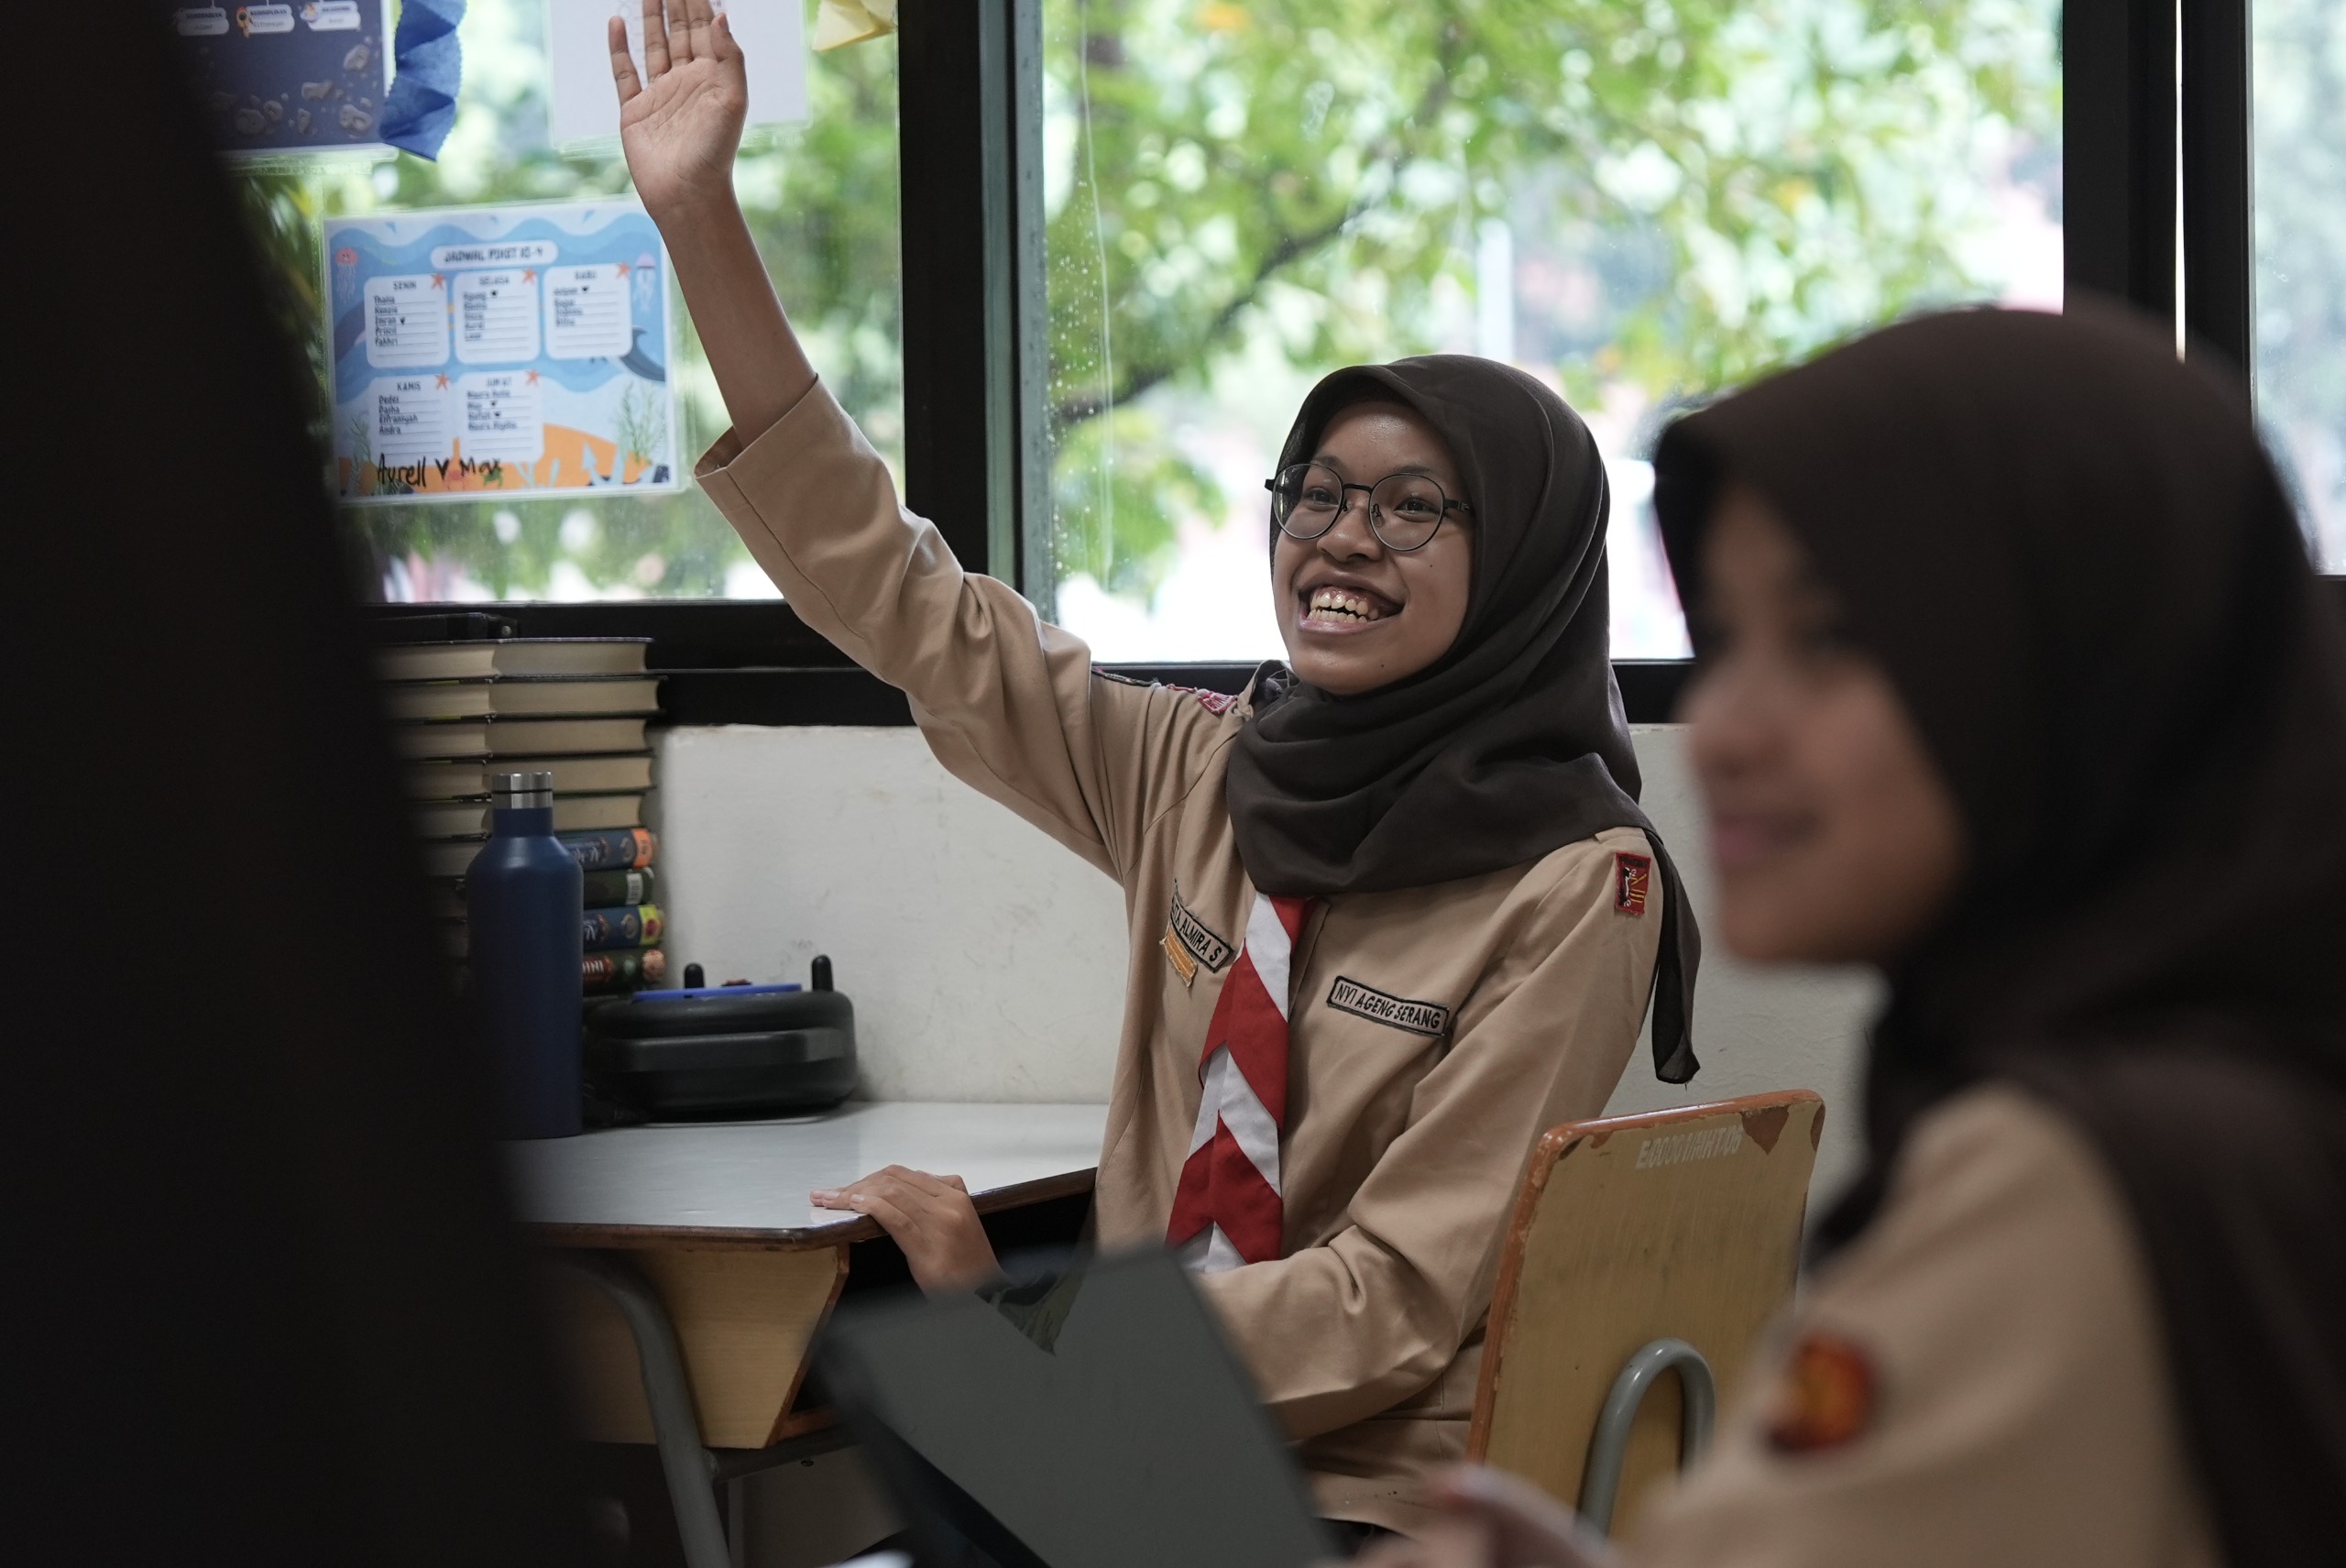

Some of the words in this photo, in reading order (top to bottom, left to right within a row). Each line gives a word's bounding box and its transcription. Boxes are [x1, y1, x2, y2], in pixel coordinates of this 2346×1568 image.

[392, 280, 417, 291] SENIN
[1178, 916, 1211, 956] ALMIRA
[1209, 945, 1223, 962] S
[1334, 982, 1358, 1005] NYI
[1355, 992, 1397, 1018] AGENG
[1393, 1004, 1442, 1029] SERANG
